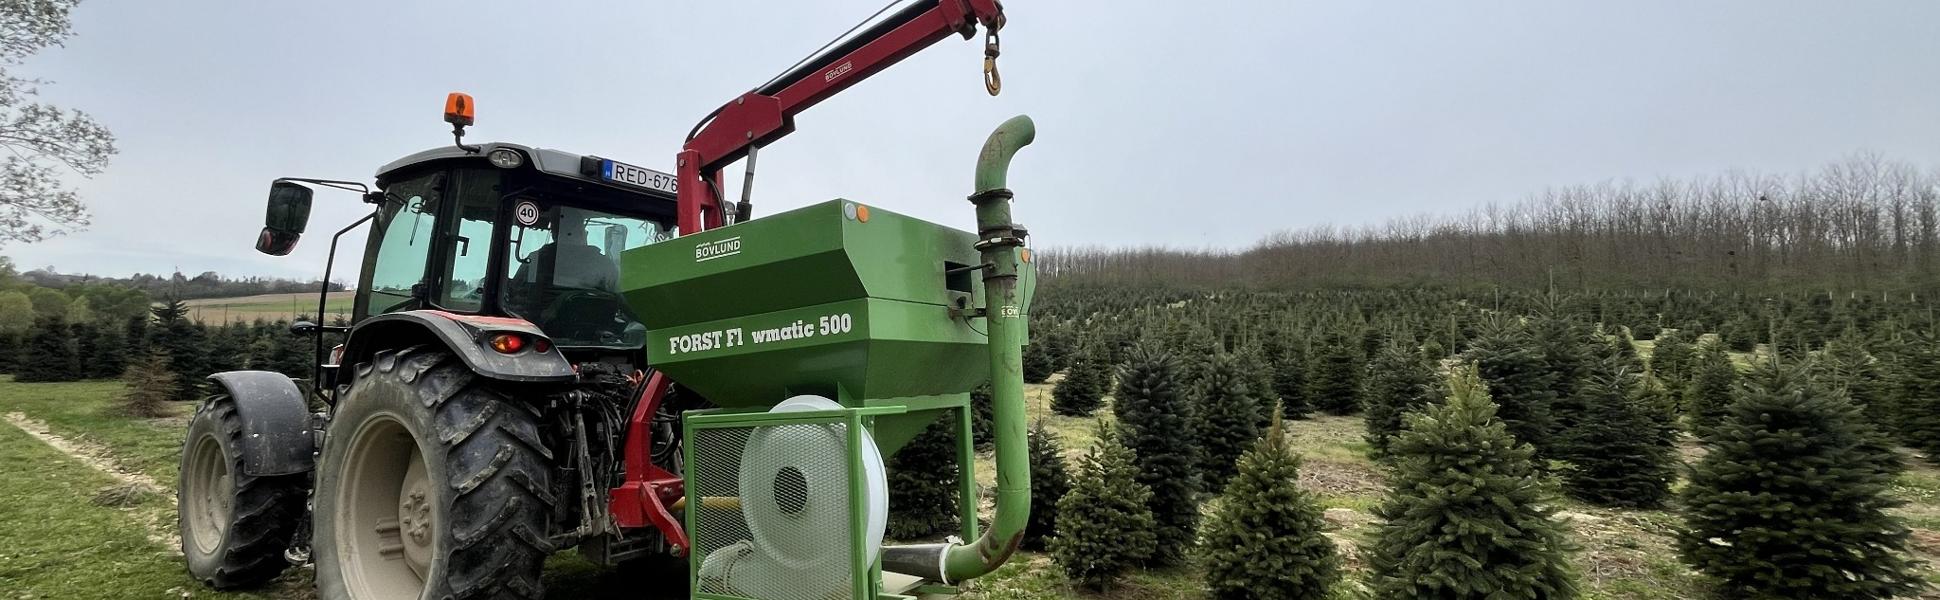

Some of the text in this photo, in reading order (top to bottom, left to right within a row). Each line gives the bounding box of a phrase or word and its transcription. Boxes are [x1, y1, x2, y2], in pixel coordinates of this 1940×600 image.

[615, 164, 677, 192] RED-676
[520, 208, 534, 218] 40
[695, 240, 741, 259] BOVLUND
[669, 331, 722, 355] FORST
[820, 313, 852, 336] 500
